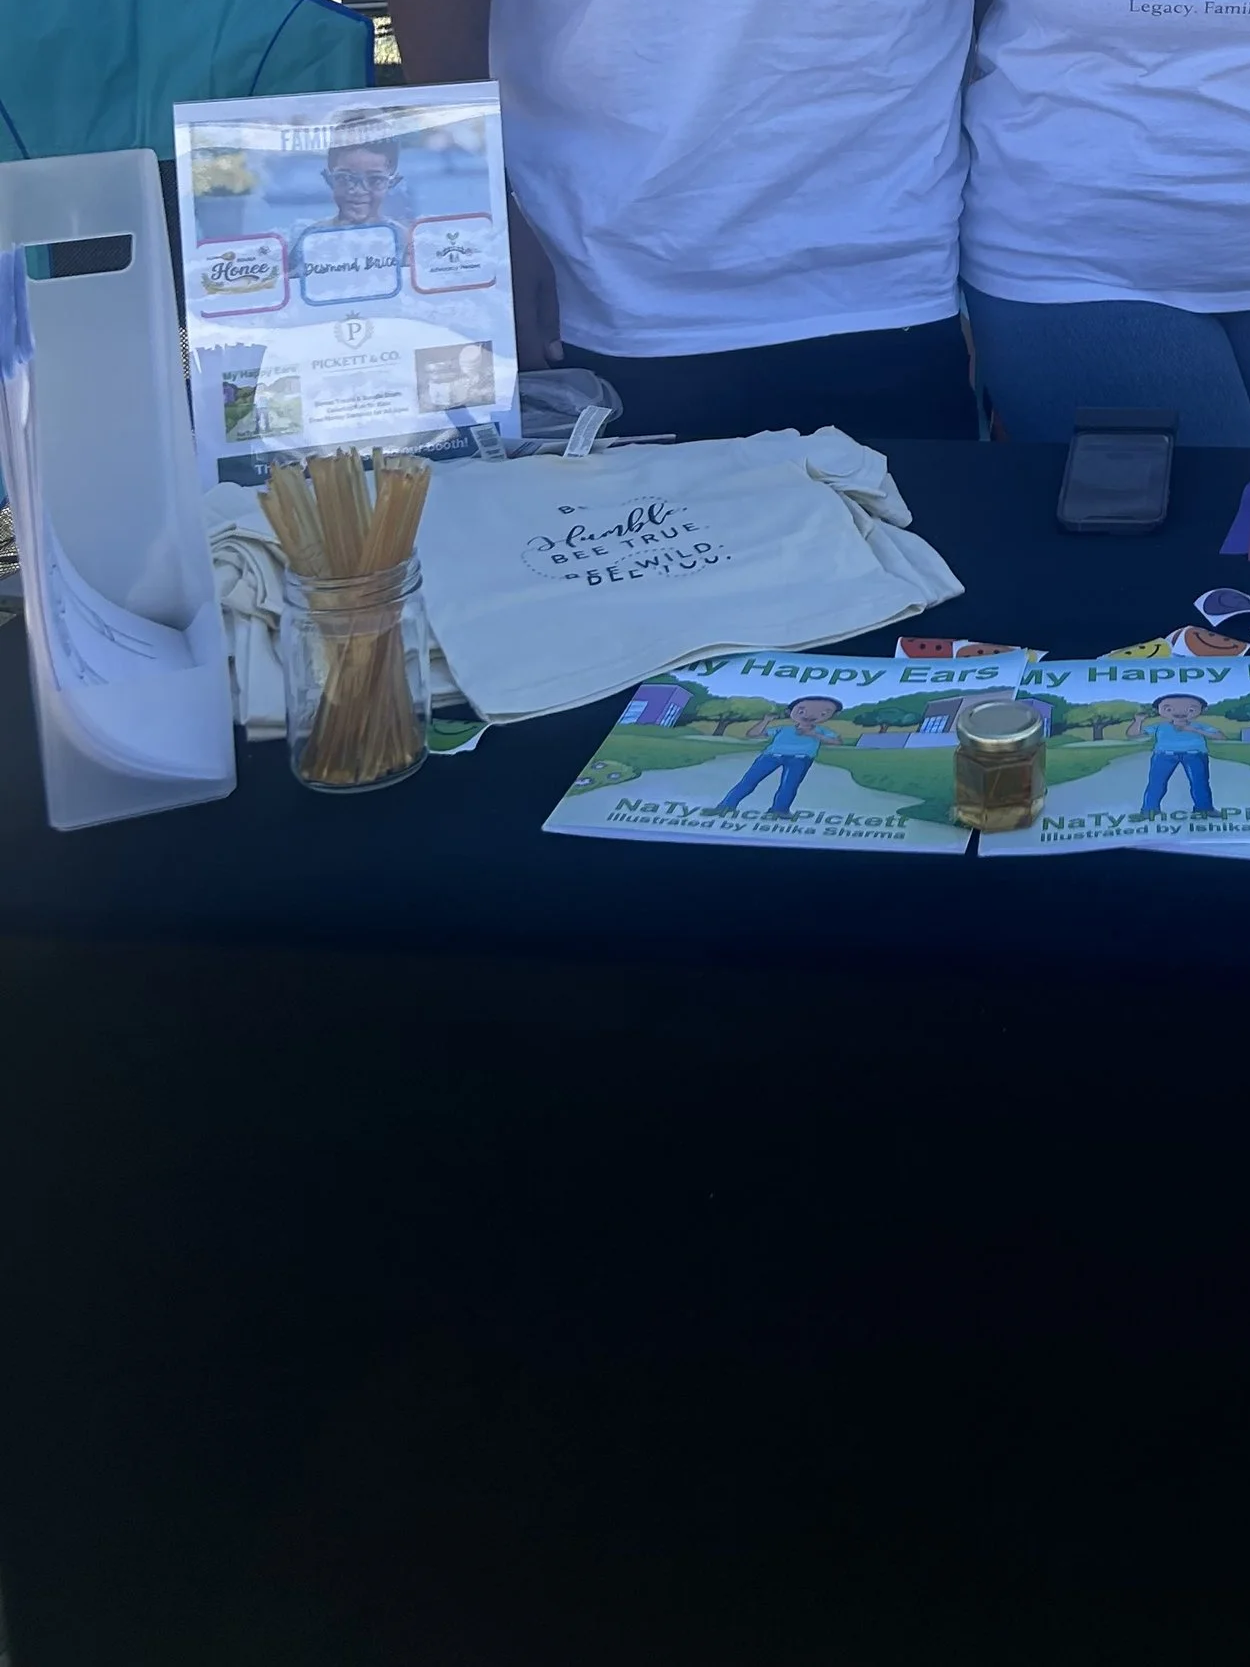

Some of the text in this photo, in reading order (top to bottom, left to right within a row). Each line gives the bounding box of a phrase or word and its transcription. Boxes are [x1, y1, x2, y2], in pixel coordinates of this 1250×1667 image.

[1129, 0, 1198, 16] Legacy.
[347, 323, 362, 341] P
[311, 355, 367, 370] PICKETT
[551, 545, 609, 564] BEE
[740, 658, 999, 686] Happy Ears
[1087, 666, 1232, 684] Happy
[606, 812, 906, 840] Illustrated by Ishika Sharma
[790, 808, 909, 828] Pickett
[1040, 823, 1149, 842] Illustrated
[1156, 822, 1182, 834] by
